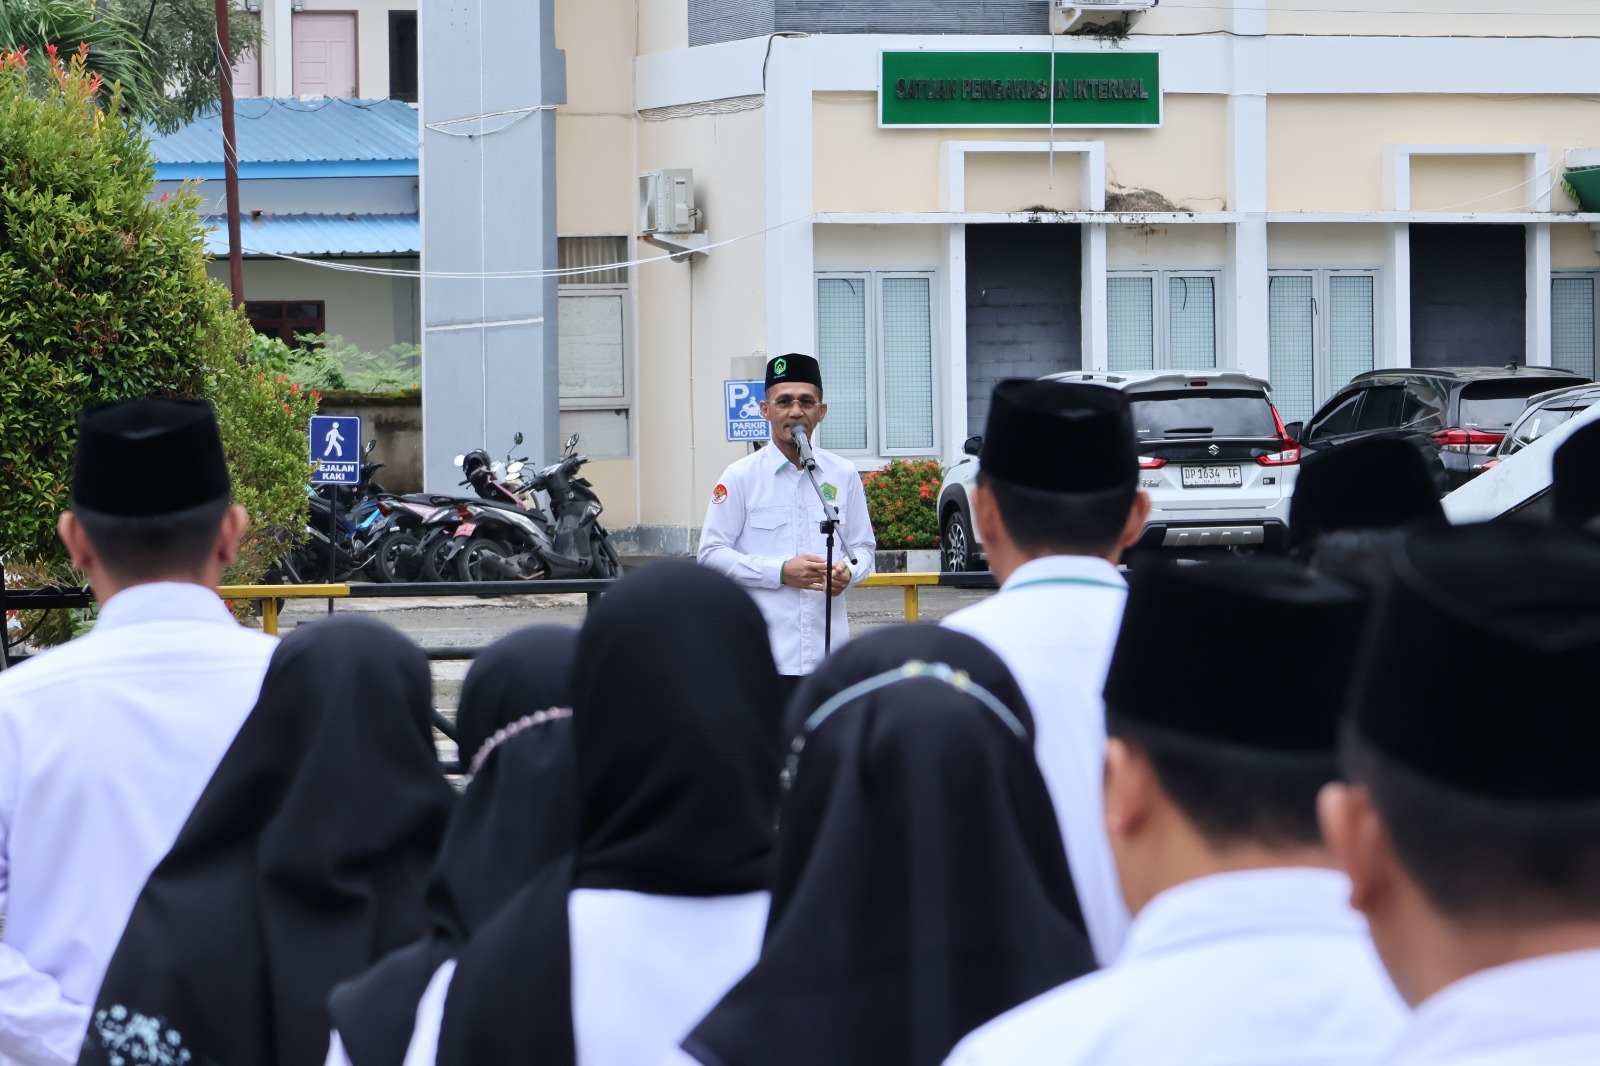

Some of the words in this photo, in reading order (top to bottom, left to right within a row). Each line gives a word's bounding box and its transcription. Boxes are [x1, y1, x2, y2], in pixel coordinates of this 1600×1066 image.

[895, 77, 957, 99] SATUAN
[962, 78, 1069, 99] PENGAWASAN
[1073, 79, 1149, 99] INTERNAL
[729, 384, 749, 408] P
[733, 429, 767, 437] MOTOR
[317, 464, 354, 472] EJALAN
[322, 472, 345, 480] KAKI
[1184, 468, 1196, 479] DP
[1197, 468, 1220, 479] 1634
[1226, 468, 1238, 479] TF
